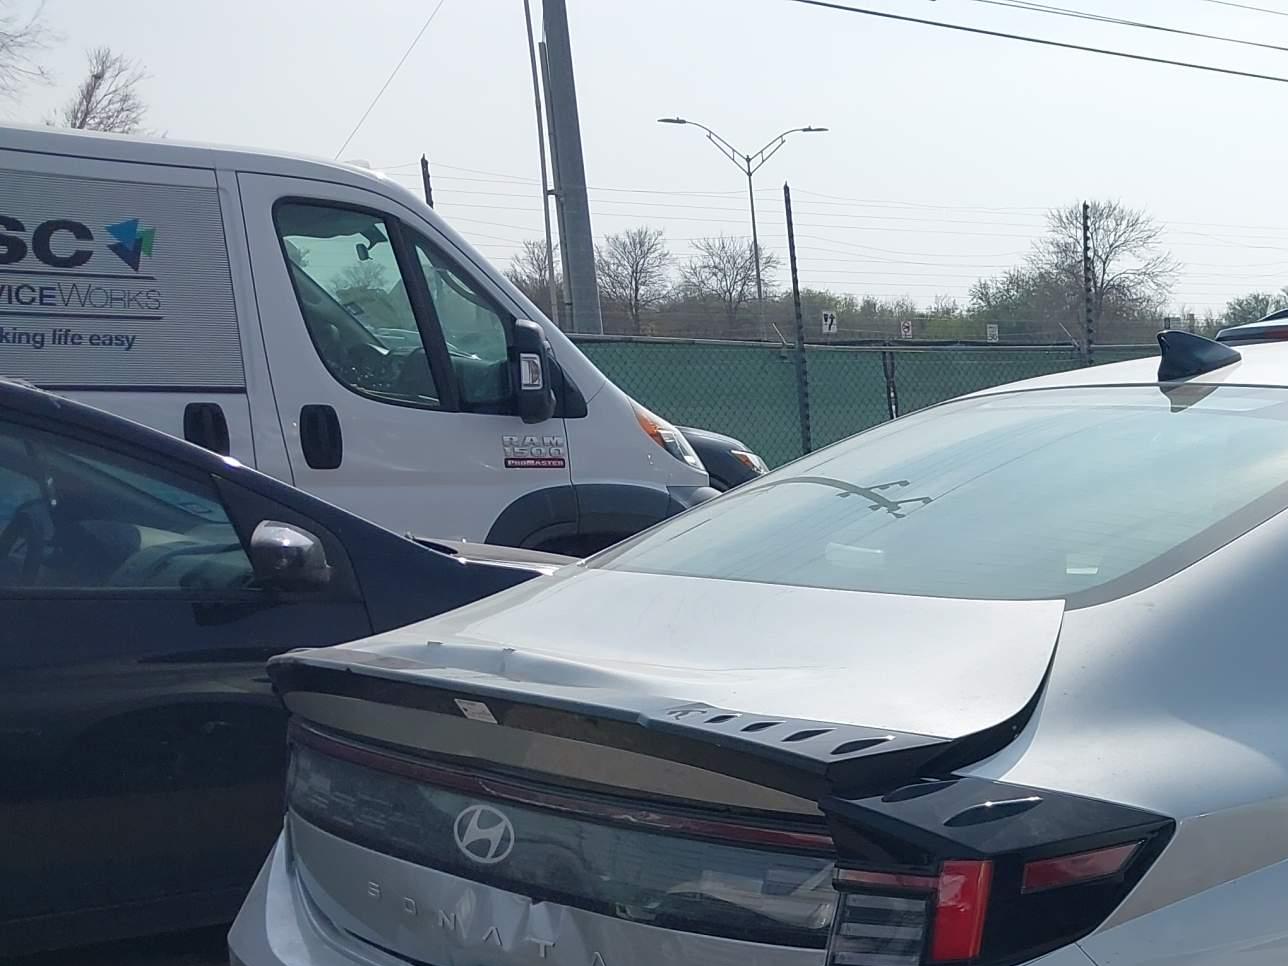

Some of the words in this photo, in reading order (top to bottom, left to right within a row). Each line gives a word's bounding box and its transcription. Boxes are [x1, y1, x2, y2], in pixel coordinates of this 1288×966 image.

[52, 328, 83, 345] life
[89, 332, 137, 351] easy
[502, 434, 564, 448] RAM
[503, 446, 565, 458] 1500
